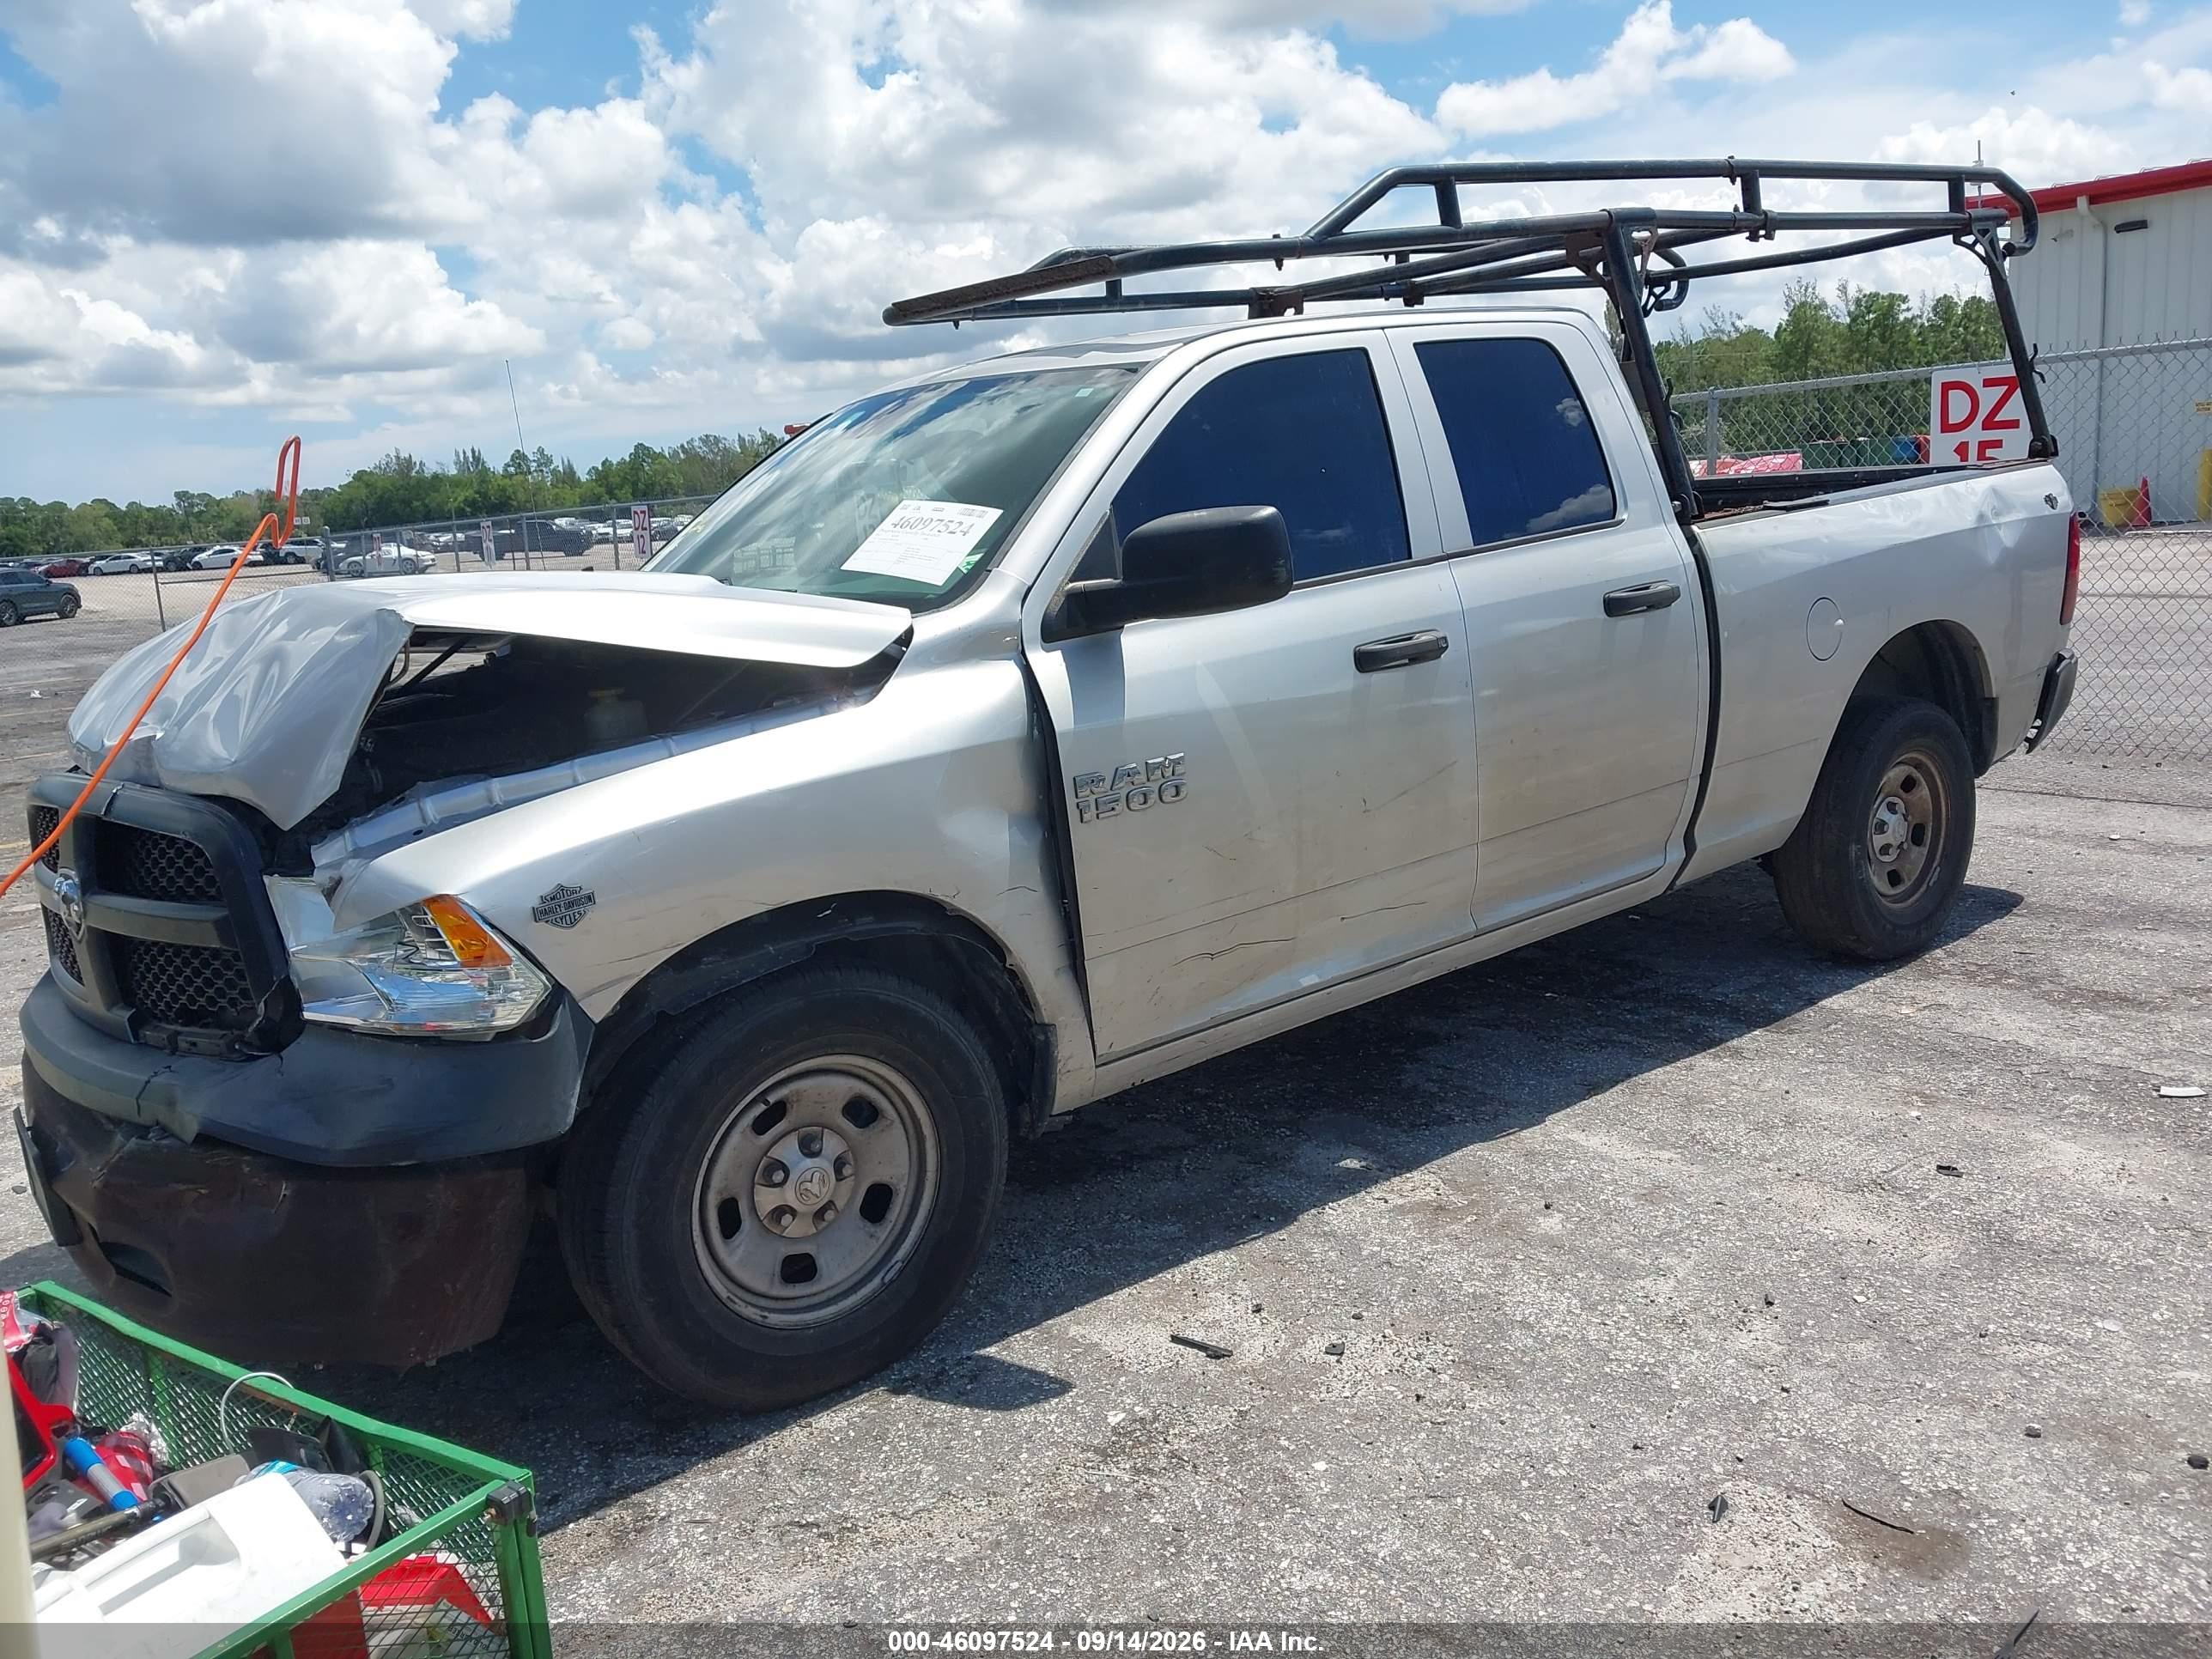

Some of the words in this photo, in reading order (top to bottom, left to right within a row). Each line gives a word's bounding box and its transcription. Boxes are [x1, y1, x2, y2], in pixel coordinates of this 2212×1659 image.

[1940, 375, 2021, 434] DZ
[633, 510, 647, 531] DZ
[890, 515, 975, 537] 46097524
[637, 534, 646, 554] 12
[1073, 751, 1188, 799] RAM
[1076, 778, 1189, 824] 1500
[538, 894, 592, 918] HARLEY-DAVIDSON
[550, 888, 579, 902] MOTOR
[554, 910, 583, 926] CYCLES
